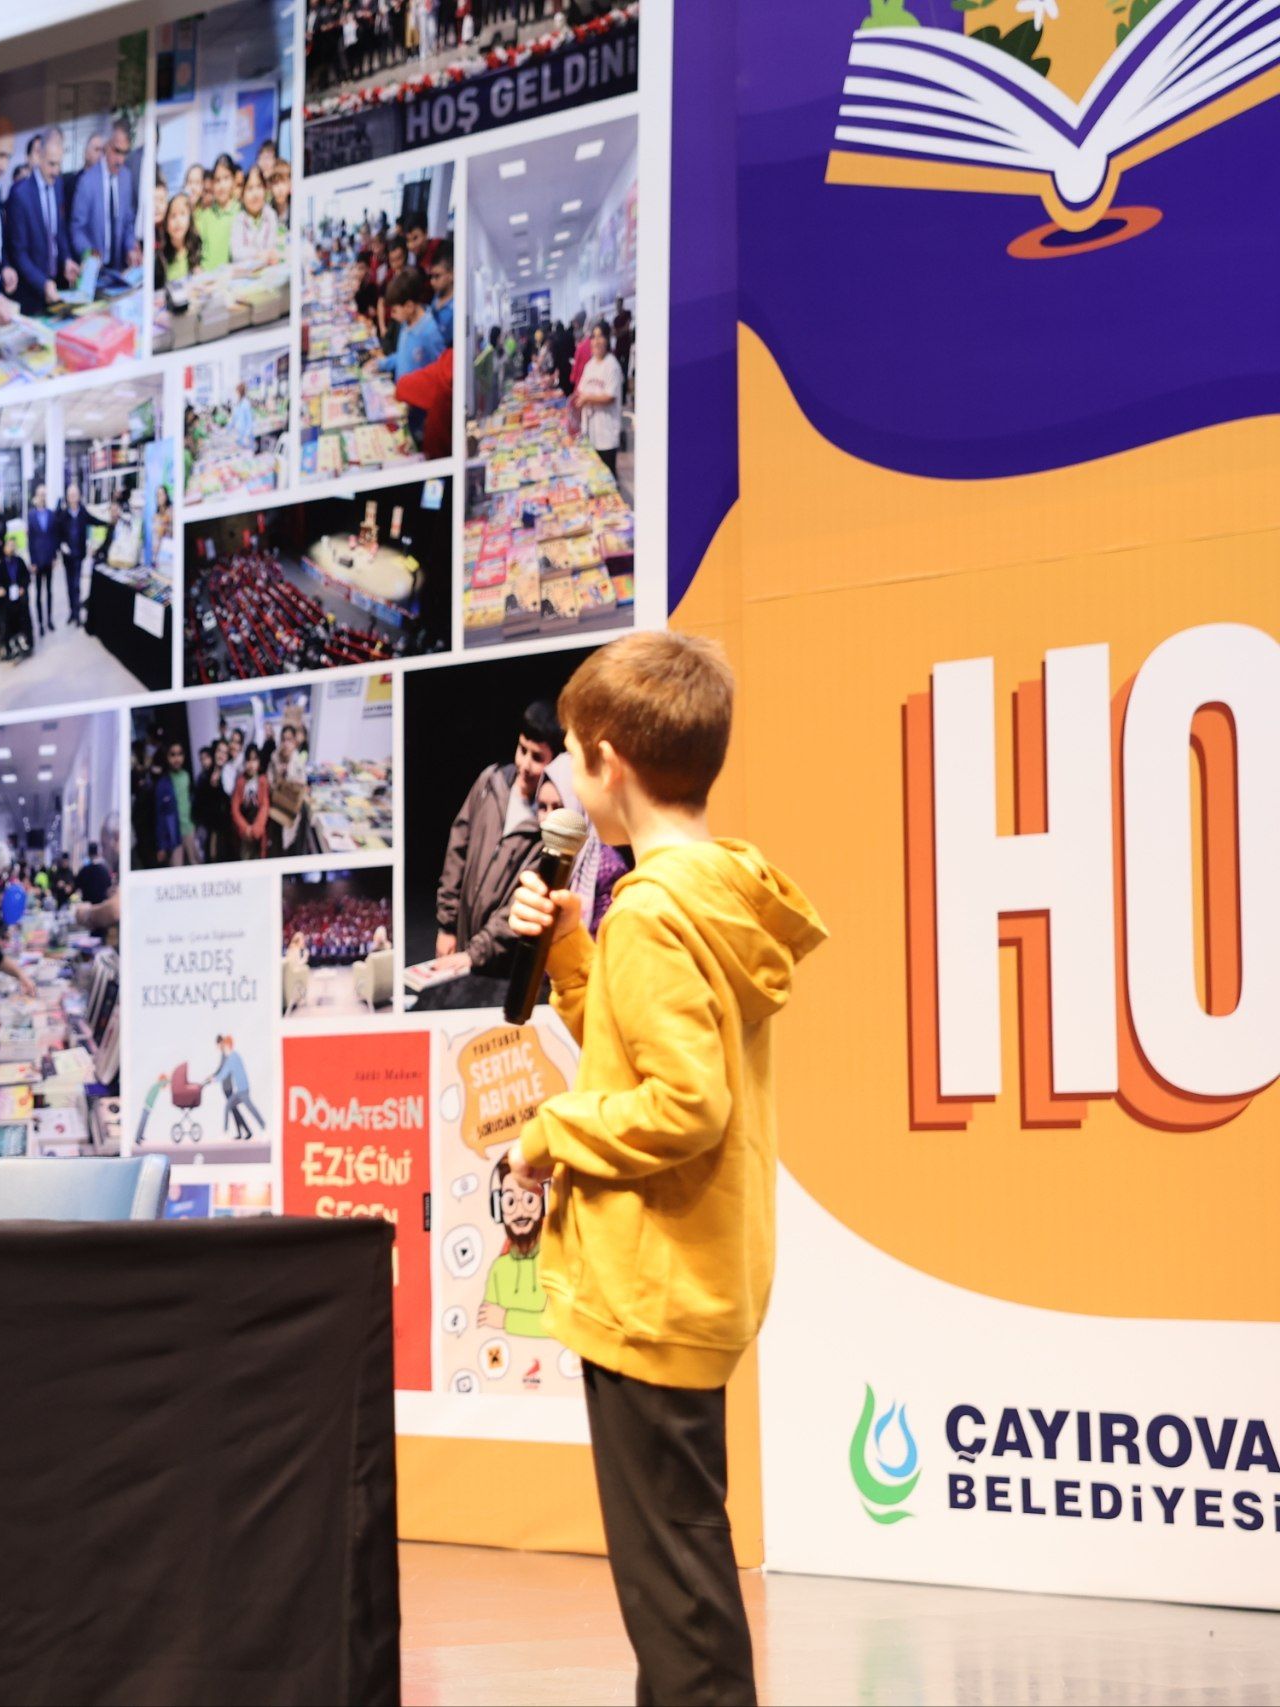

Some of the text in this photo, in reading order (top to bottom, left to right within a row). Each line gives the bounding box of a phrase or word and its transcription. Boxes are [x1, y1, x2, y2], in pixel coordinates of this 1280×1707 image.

[405, 86, 480, 143] HOŞ
[164, 947, 235, 976] KARDEŞ
[141, 975, 259, 1009] KISKANÇLIĞI
[469, 1041, 535, 1089] SERTAÇ
[288, 1084, 425, 1132] DOMATESİN
[945, 1403, 1280, 1474] ÇAYIROVA
